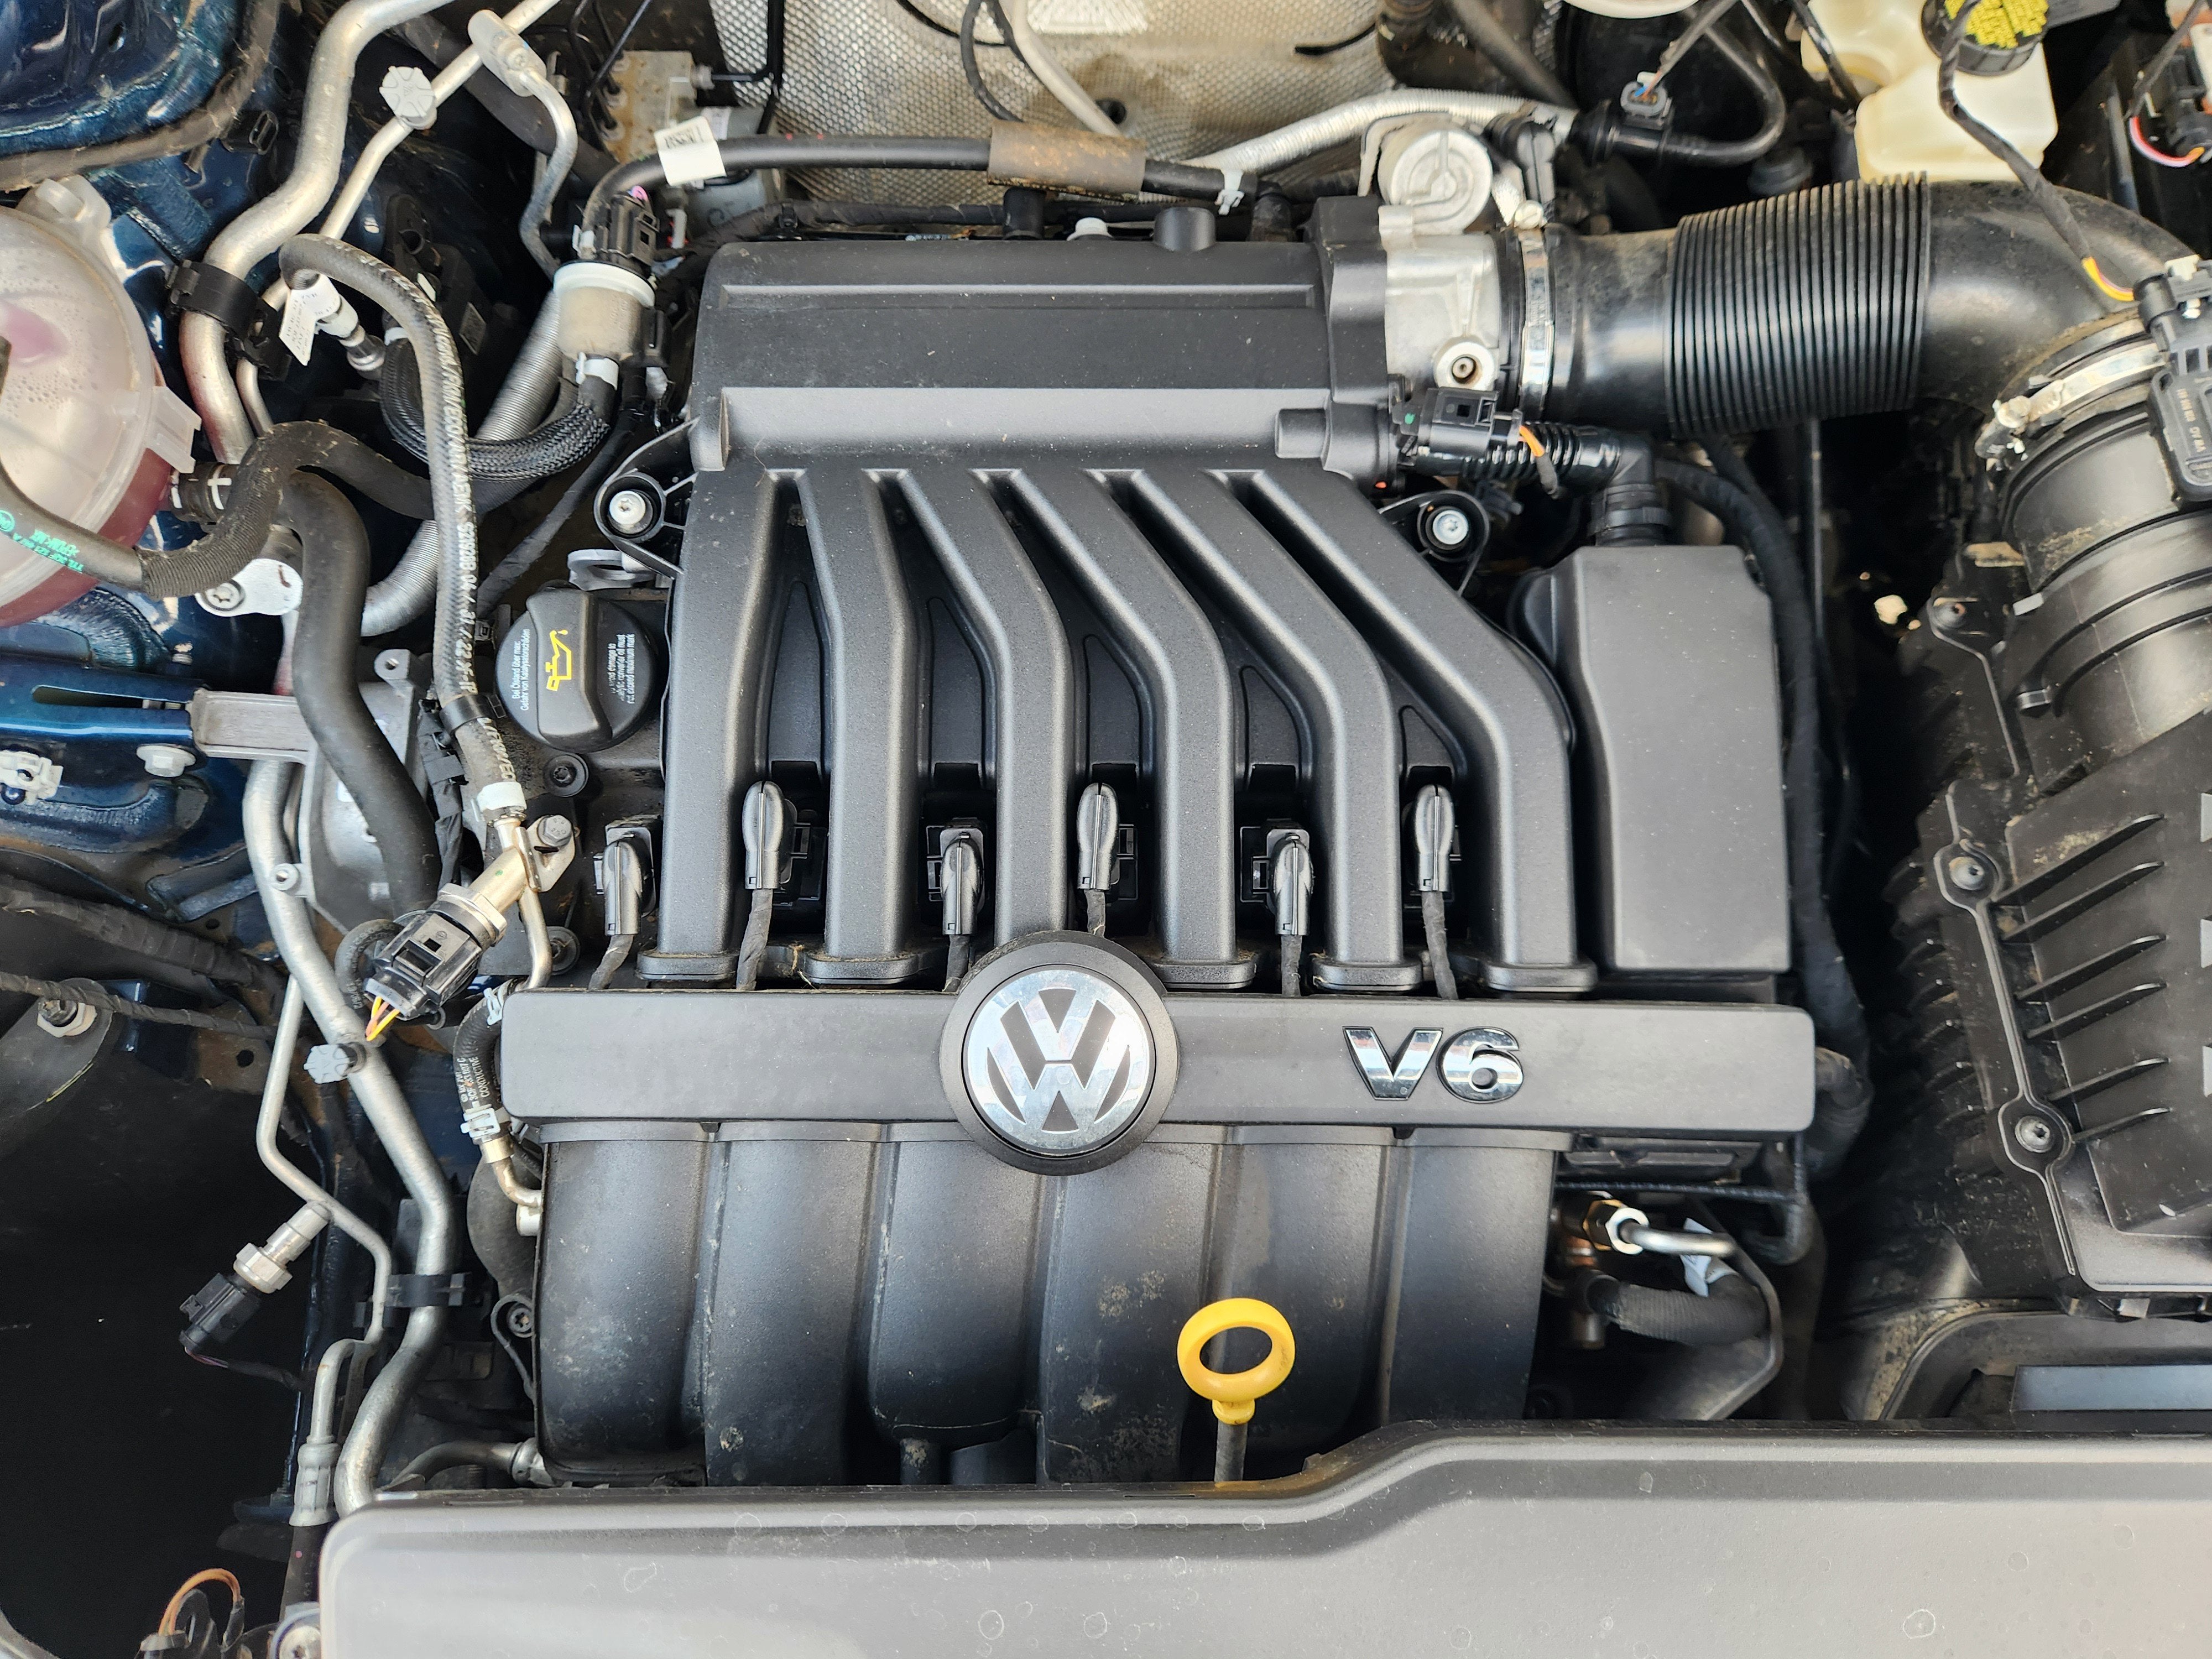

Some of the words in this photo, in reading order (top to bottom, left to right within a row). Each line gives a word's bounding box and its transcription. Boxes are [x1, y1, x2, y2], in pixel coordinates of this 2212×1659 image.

[455, 639, 472, 659] 22
[616, 634, 626, 648] must
[625, 634, 635, 648] mark
[607, 649, 618, 671] damage
[616, 656, 625, 680] converter
[625, 648, 635, 674] maximum
[512, 690, 520, 699] Bei
[625, 675, 635, 694] exceed
[520, 692, 529, 711] Gefahr
[967, 969, 1150, 1150] VW
[1342, 1026, 1524, 1104] V6
[468, 1056, 491, 1098] CONDUCTIVE
